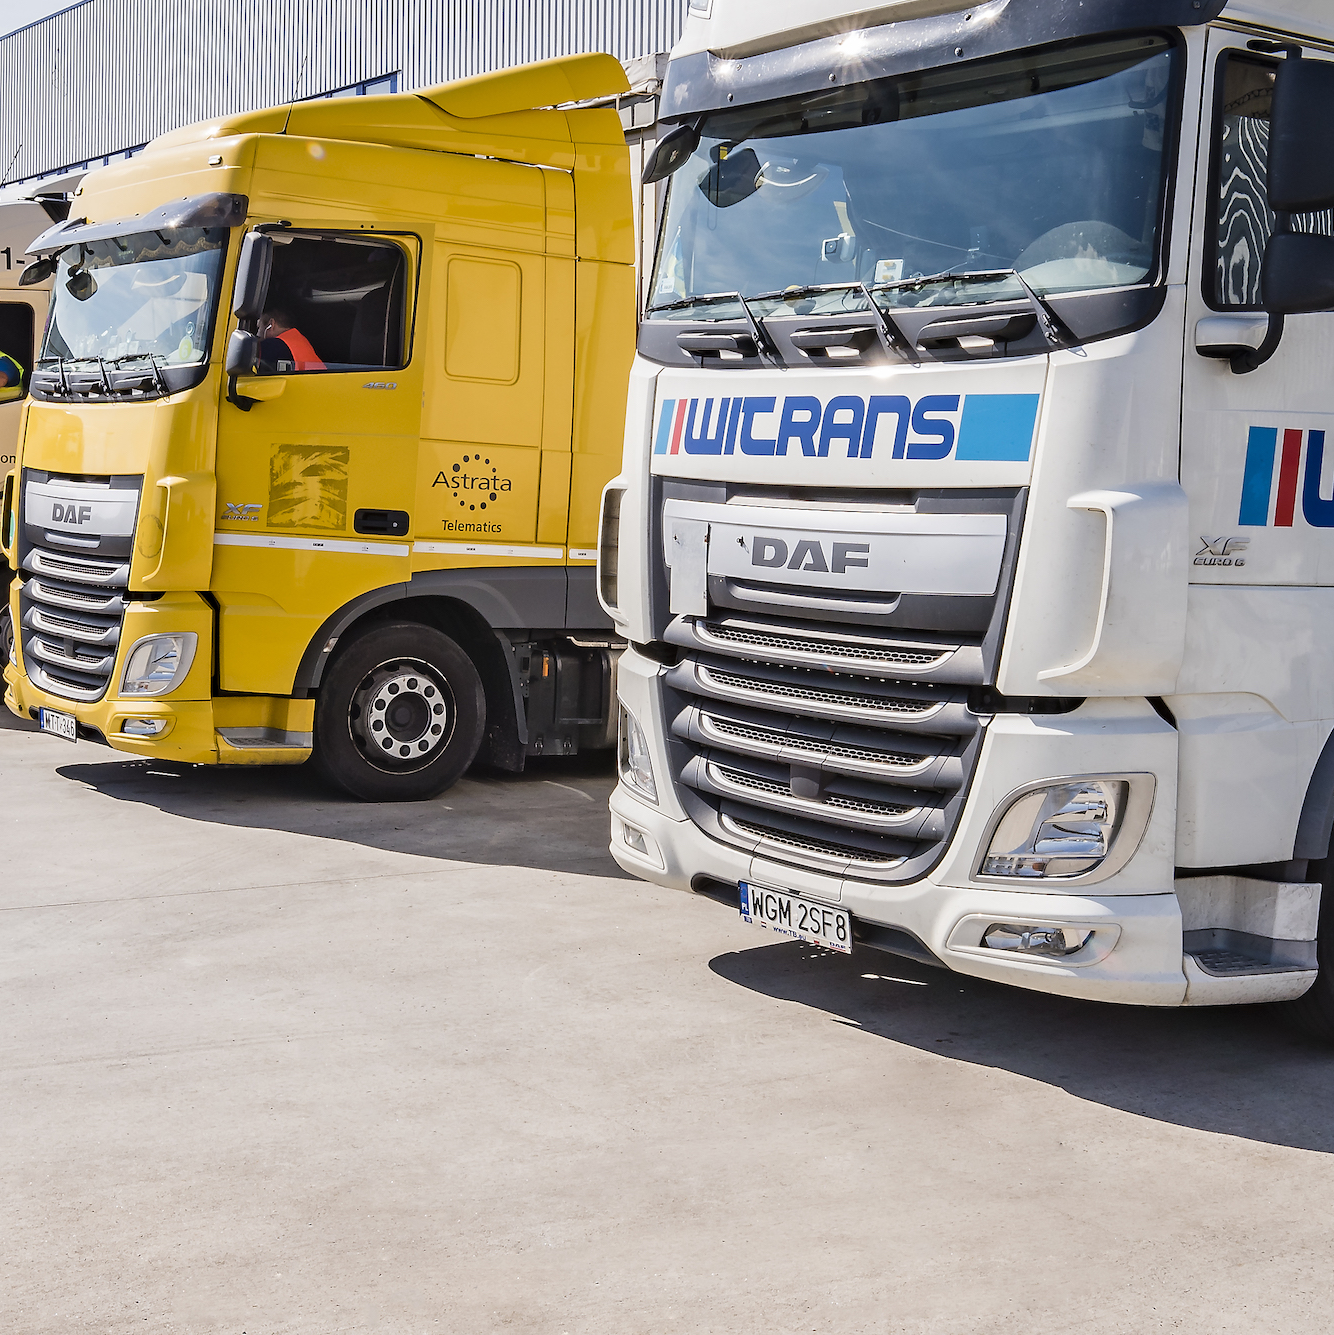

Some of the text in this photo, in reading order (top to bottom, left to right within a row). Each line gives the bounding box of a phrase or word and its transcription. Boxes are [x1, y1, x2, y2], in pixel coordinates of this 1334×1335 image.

[362, 382, 397, 390] 460
[684, 394, 961, 460] WITRANS
[431, 471, 512, 491] Astrata
[52, 503, 91, 525] DAF
[224, 502, 263, 515] XF
[442, 520, 502, 533] Telematics
[752, 536, 870, 573] DAF
[1195, 536, 1251, 556] XF
[1193, 557, 1233, 567] EURO
[742, 902, 749, 912] PL
[751, 889, 847, 942] WGM 2SF8
